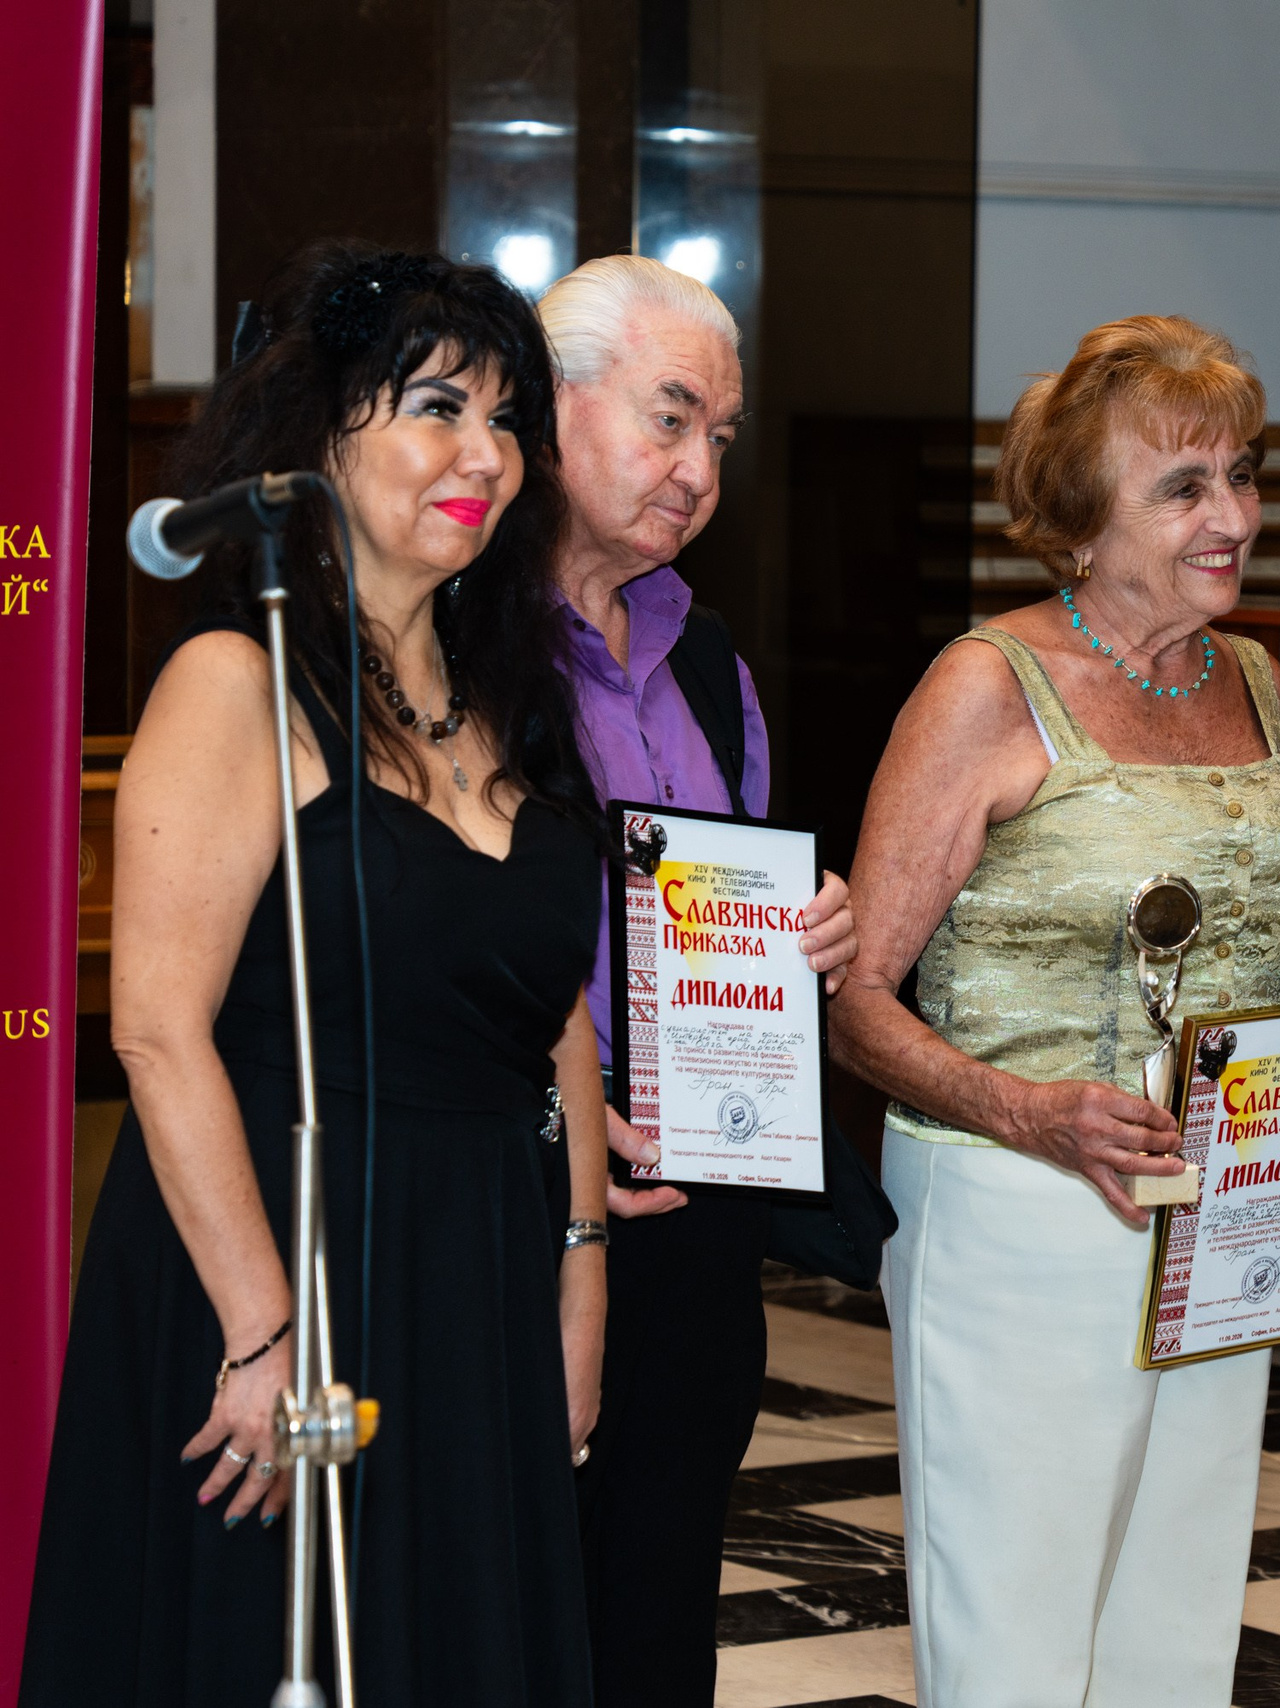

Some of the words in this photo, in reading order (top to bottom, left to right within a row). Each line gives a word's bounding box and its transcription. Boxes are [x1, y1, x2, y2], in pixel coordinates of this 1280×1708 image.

[694, 865, 708, 873] XIV
[712, 866, 768, 879] МЕЖДУНАРОДЕН
[687, 874, 707, 883] КИНО
[710, 876, 716, 884] И
[720, 877, 775, 890] ТЕЛЕВИЗИОНЕН
[712, 887, 750, 897] ФЕСТИВАЛ
[1258, 1058, 1272, 1067] XIV
[1250, 1067, 1268, 1077] КИНО
[1271, 1066, 1277, 1074] И
